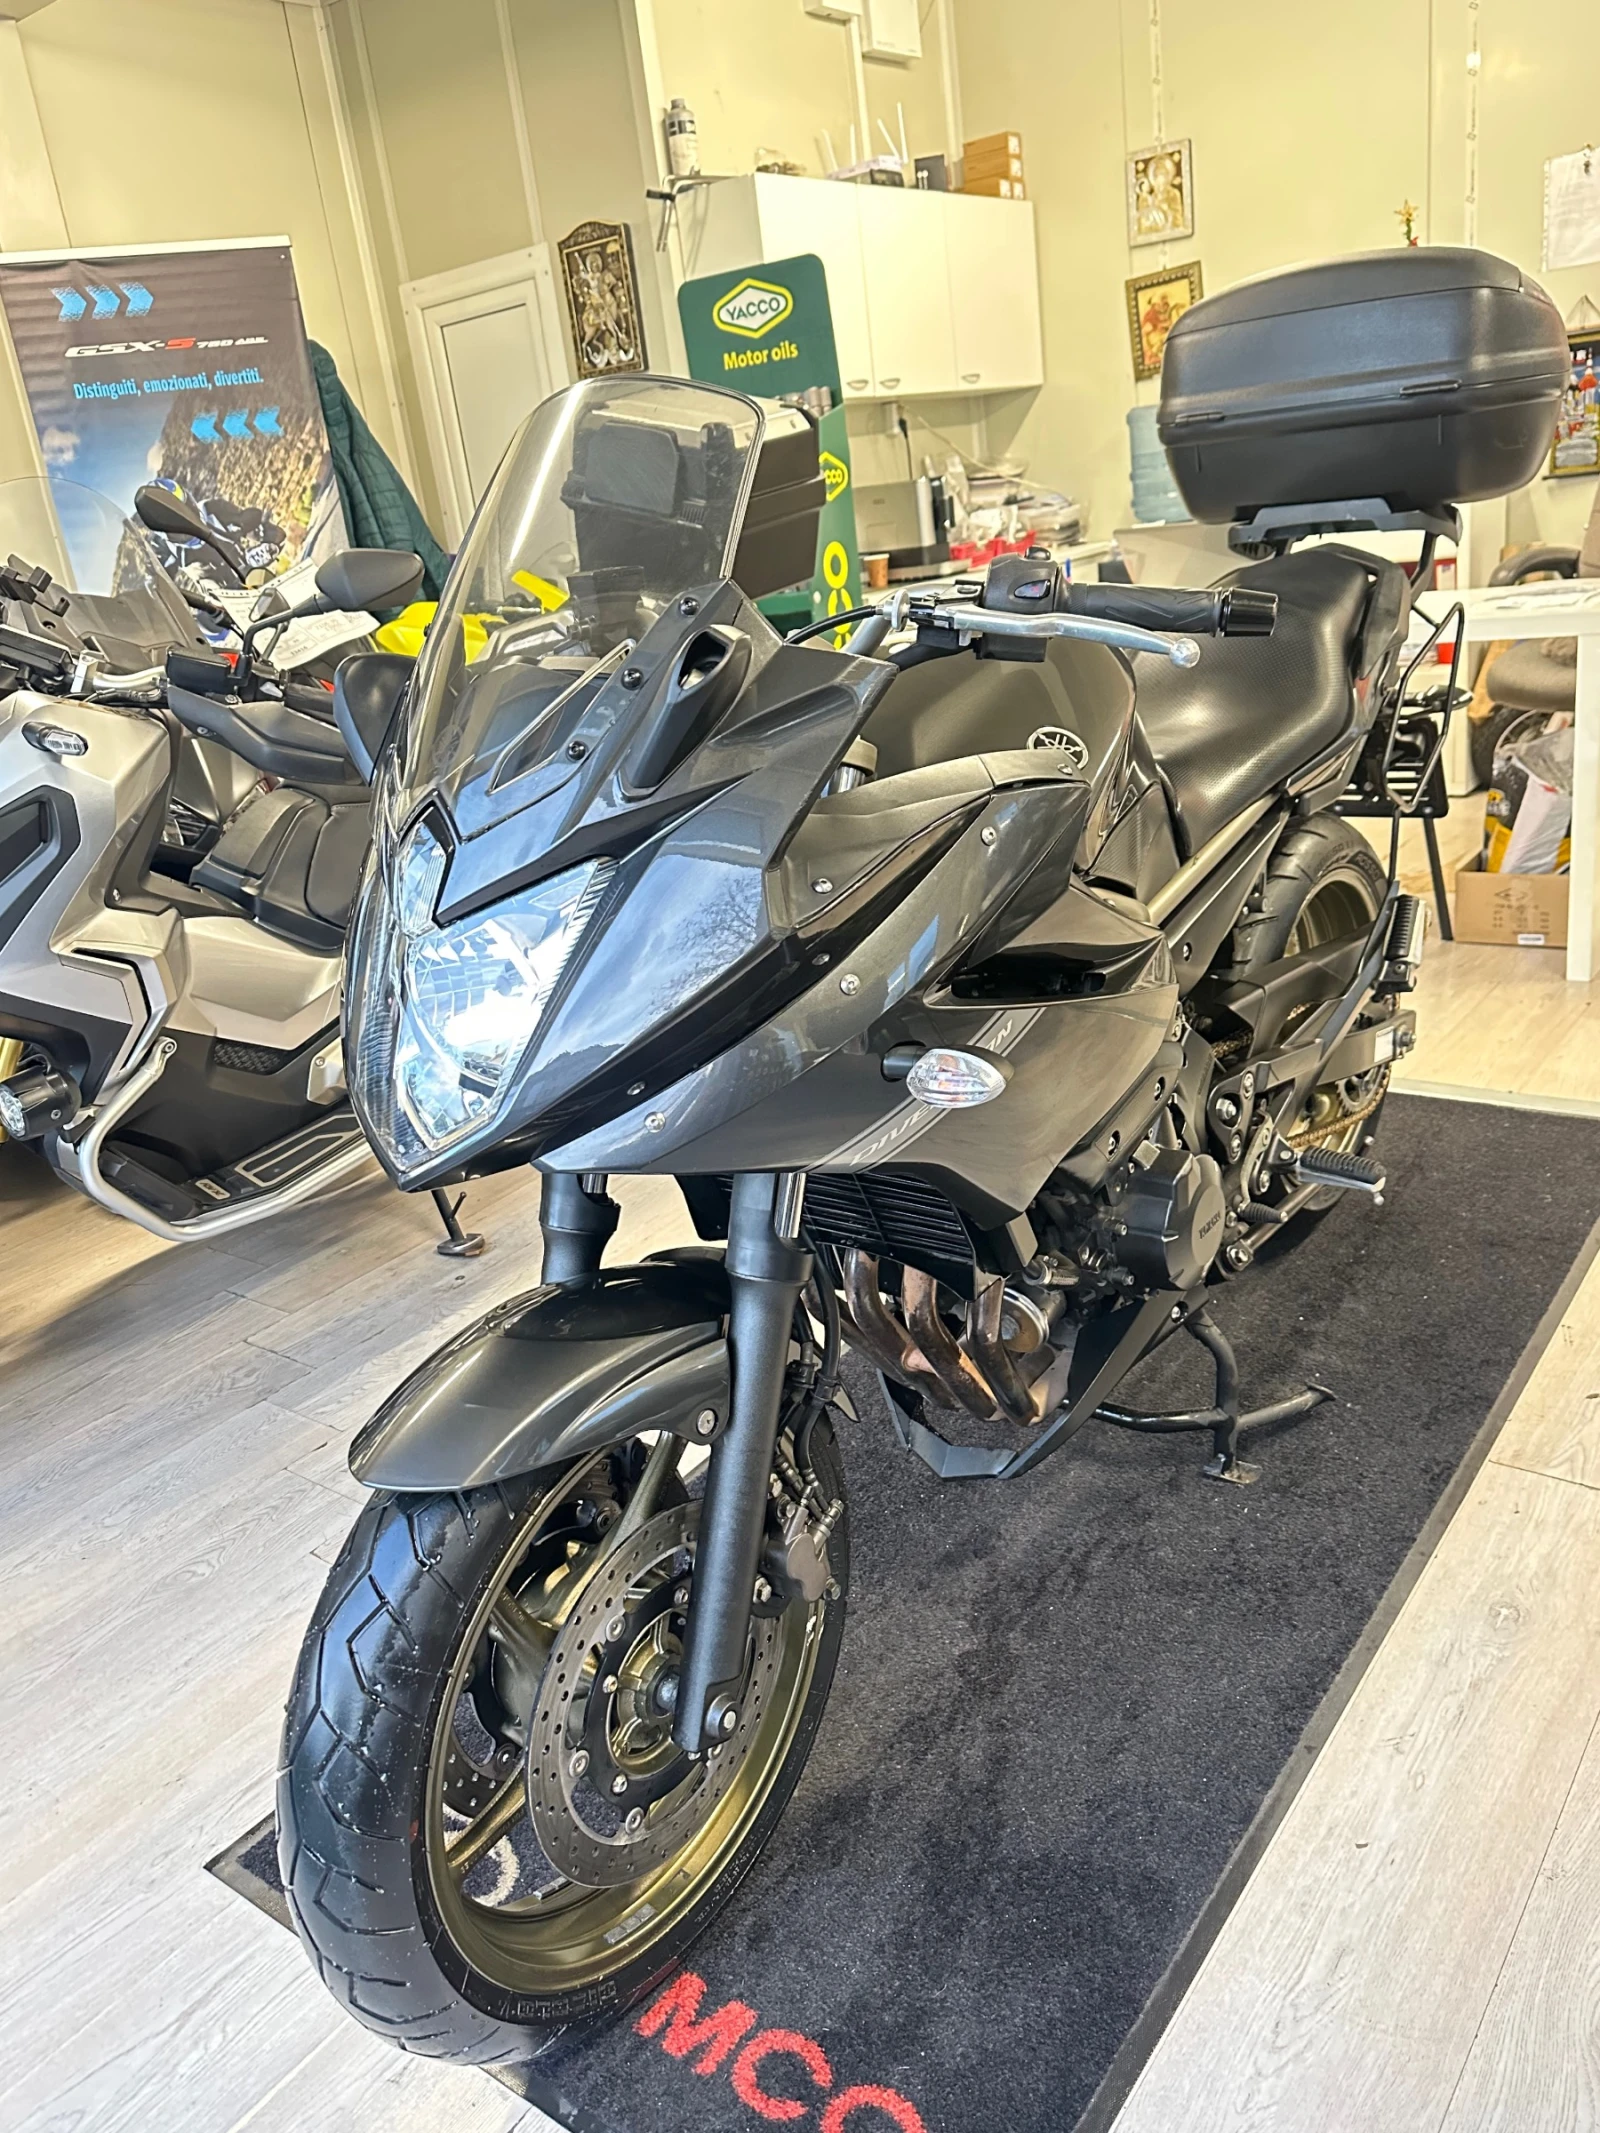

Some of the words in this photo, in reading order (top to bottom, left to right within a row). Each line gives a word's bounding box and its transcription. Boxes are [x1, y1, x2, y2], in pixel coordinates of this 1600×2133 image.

[725, 297, 781, 321] YACCO
[723, 349, 769, 371] Motor
[771, 340, 798, 362] oils
[73, 378, 142, 400] Distinguiti,
[143, 371, 213, 394] emozionati,
[214, 367, 265, 388] divertiti.
